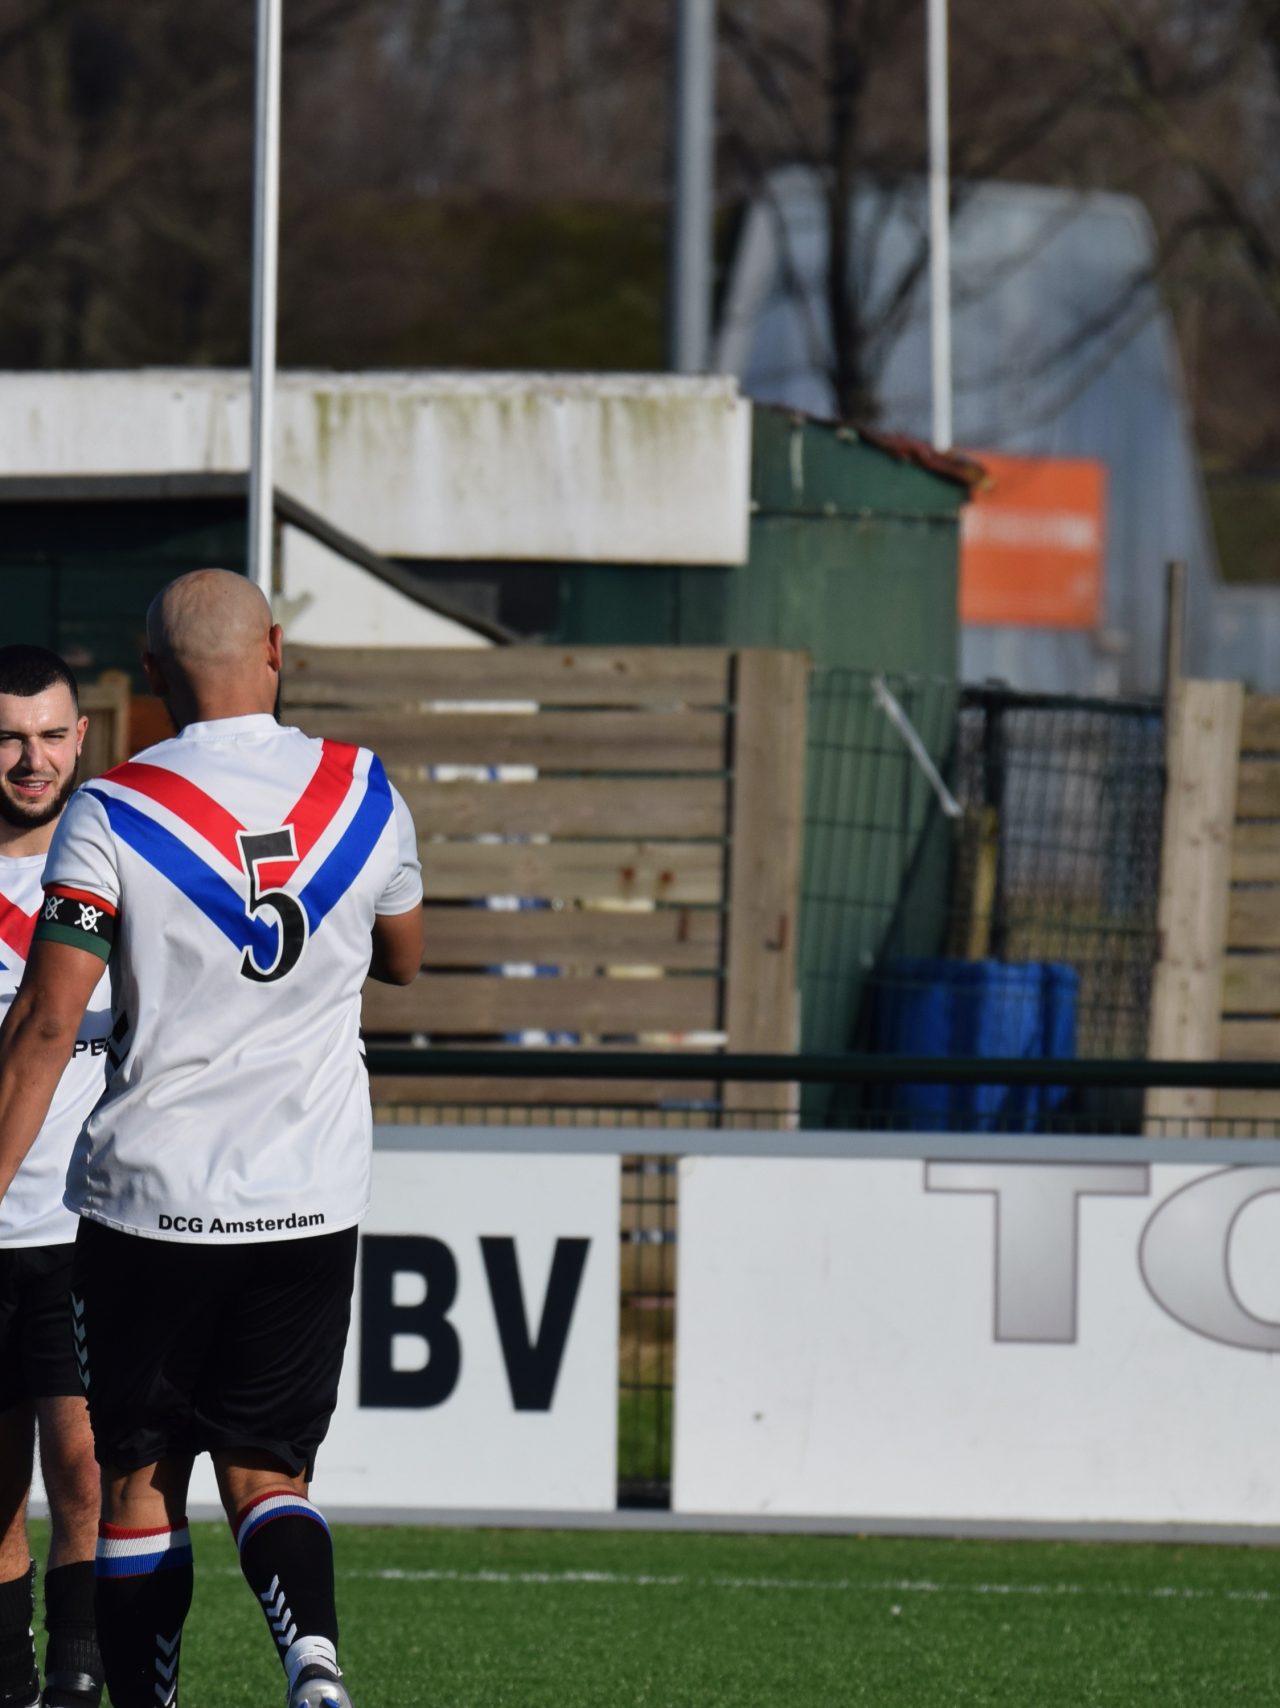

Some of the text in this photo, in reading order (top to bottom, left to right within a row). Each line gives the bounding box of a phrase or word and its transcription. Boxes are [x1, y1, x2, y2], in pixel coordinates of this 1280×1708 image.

[235, 824, 310, 982] 5
[158, 1212, 325, 1233] DCG Amsterdam
[358, 1234, 592, 1412] BV
